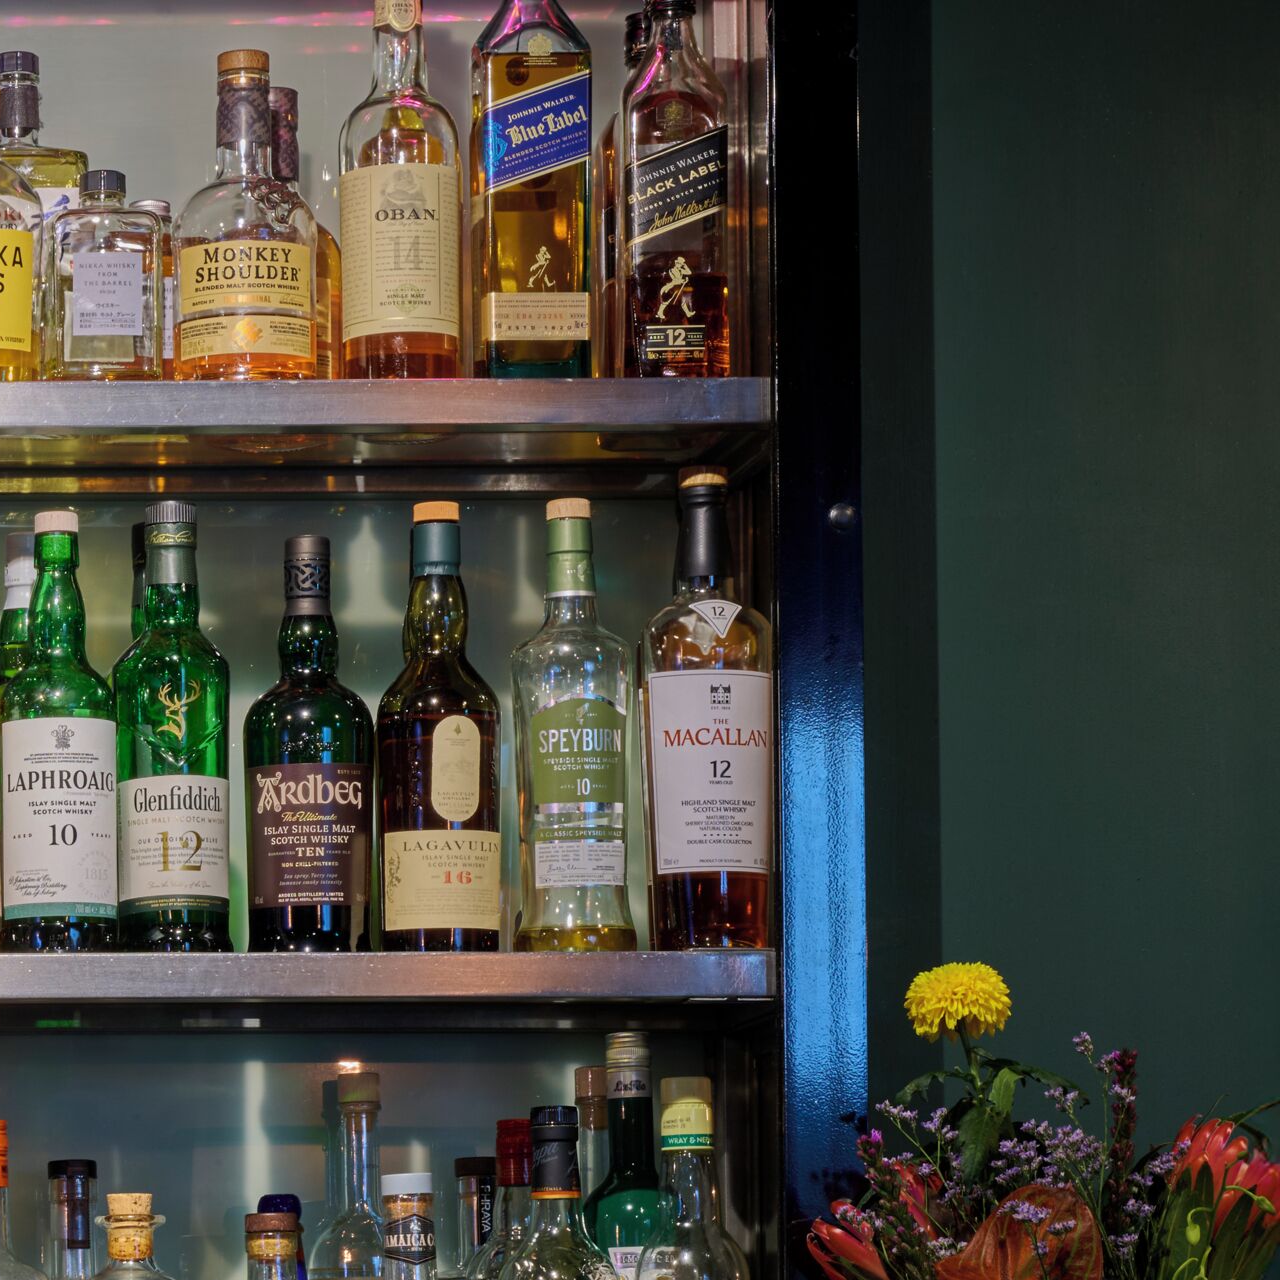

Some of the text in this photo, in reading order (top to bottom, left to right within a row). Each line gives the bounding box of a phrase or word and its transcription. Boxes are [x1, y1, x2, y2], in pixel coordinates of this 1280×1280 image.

[508, 94, 574, 124] JOHNNIE WALKER
[628, 158, 726, 205] BLACK LABEL
[374, 208, 436, 222] OBAN
[204, 247, 292, 265] MONKEY
[195, 266, 298, 284] SHOULDER
[666, 330, 686, 346] 12
[540, 728, 622, 754] SPEYBURN
[664, 728, 768, 749] MACALLAN
[710, 760, 732, 779] 12
[7, 770, 114, 794] LAPHROAIG
[133, 785, 222, 814] Glenfiddich
[48, 823, 78, 846] 10
[271, 835, 350, 846] SCOTCH WHISKY
